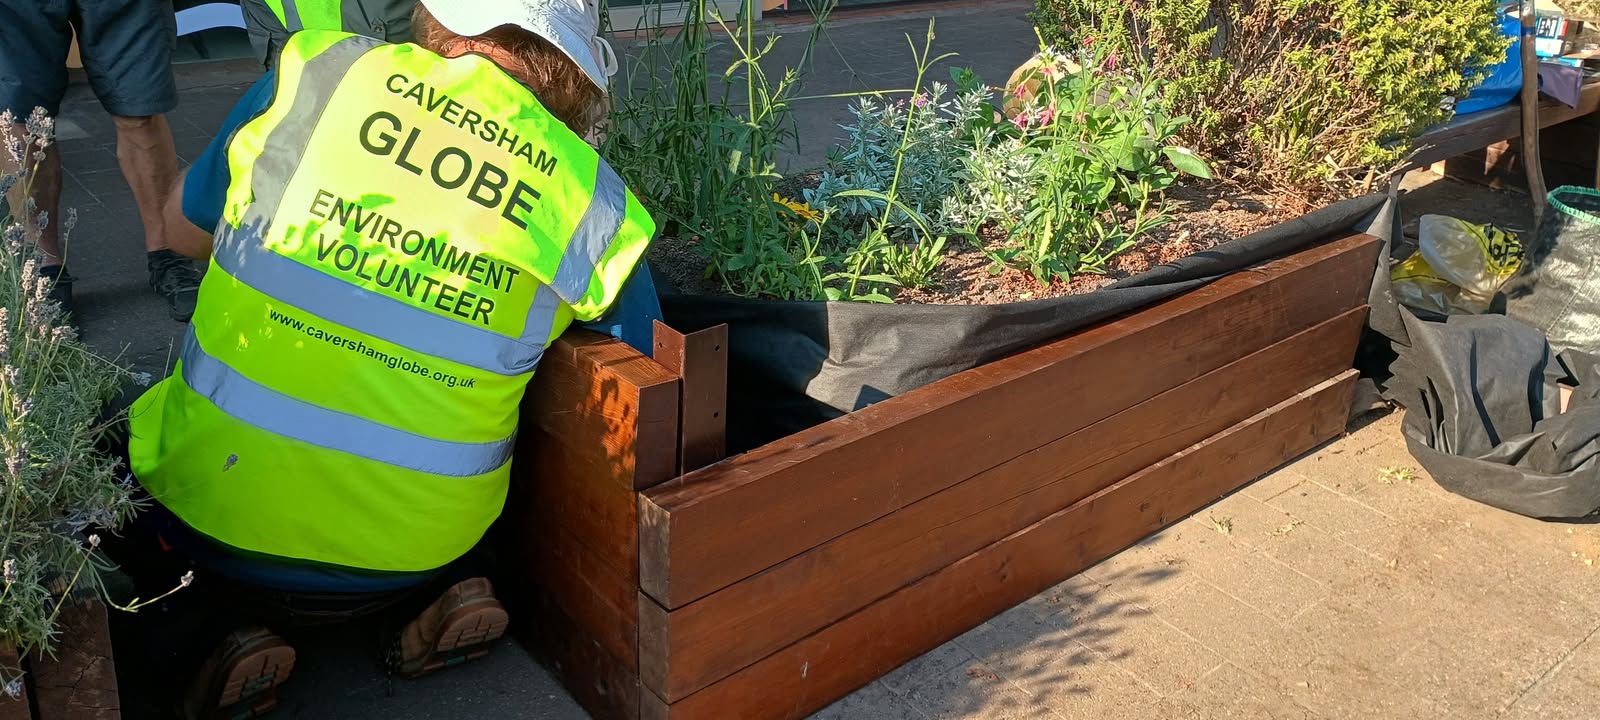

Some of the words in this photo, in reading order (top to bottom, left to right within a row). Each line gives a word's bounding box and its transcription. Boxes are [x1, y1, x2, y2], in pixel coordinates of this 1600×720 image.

[359, 111, 541, 230] GLOBE
[386, 73, 557, 177] CAVERSHAM
[309, 189, 520, 293] ENVIRONMENT
[317, 234, 495, 324] VOLUNTEER
[269, 308, 475, 388] www.cavershamglobe.org.uk
